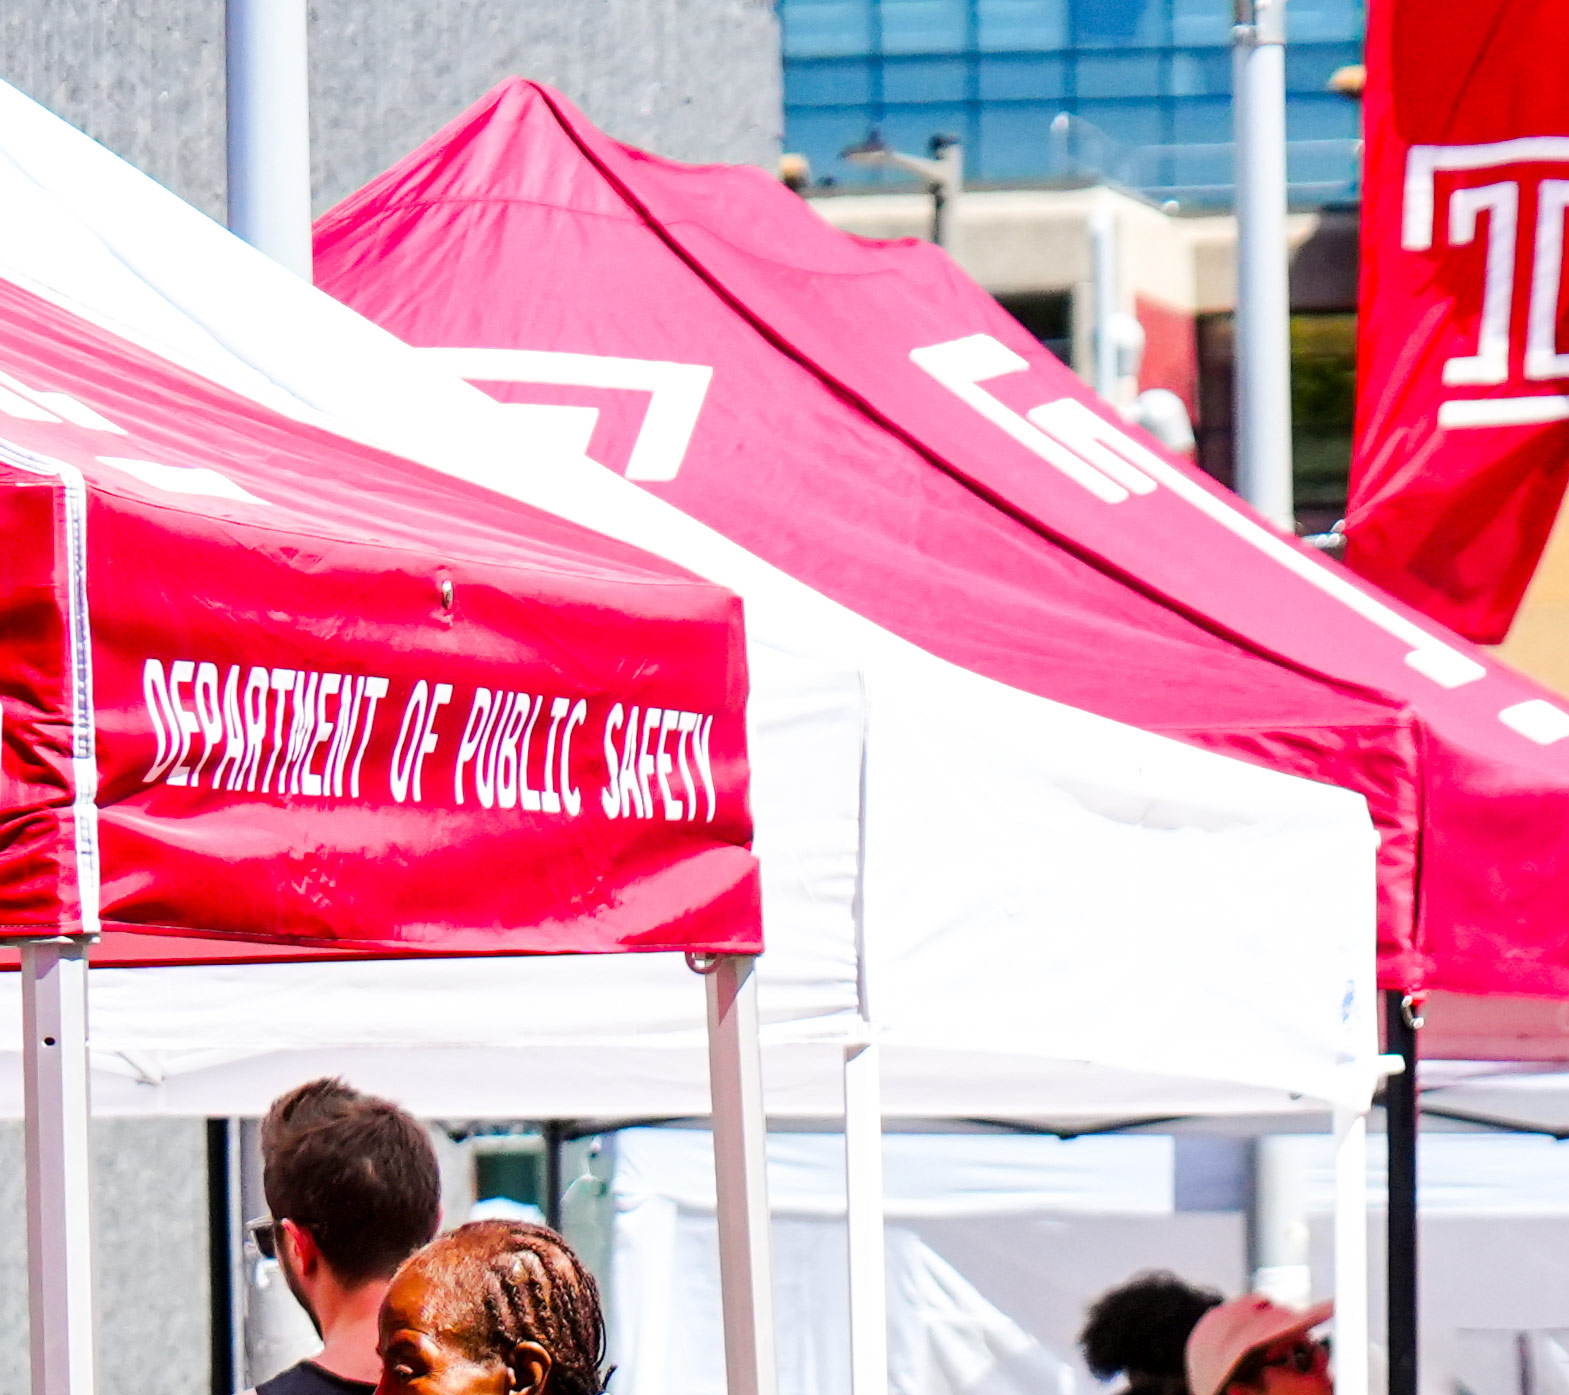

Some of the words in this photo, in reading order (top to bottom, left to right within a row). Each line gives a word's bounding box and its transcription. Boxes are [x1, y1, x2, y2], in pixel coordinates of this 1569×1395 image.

[143, 659, 389, 798] DEPARTMENT
[391, 680, 454, 804] OF
[455, 687, 588, 816] PUBLIC
[600, 703, 718, 823] SAFETY
